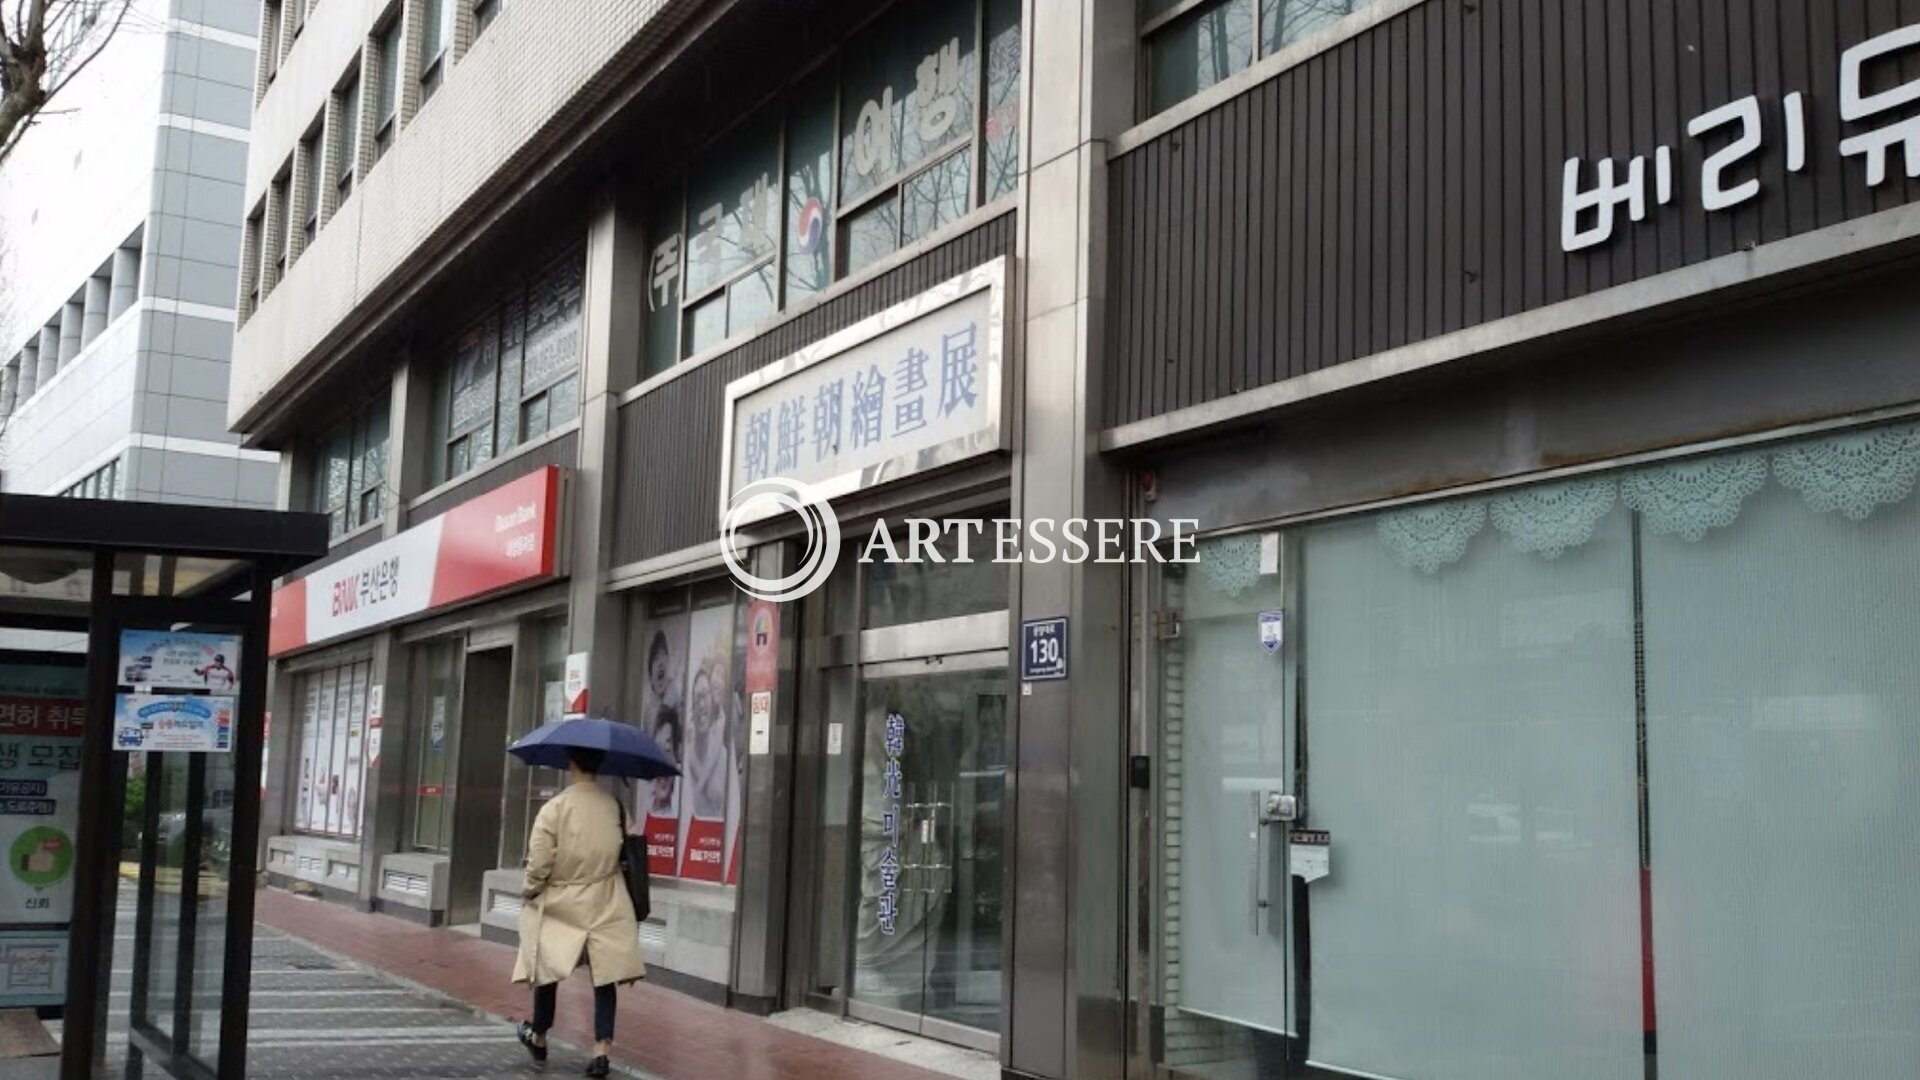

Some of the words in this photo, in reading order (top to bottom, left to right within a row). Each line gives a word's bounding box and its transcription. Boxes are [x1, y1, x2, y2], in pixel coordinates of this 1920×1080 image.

[854, 36, 961, 176] 여행
[331, 574, 360, 617] BNK
[359, 555, 400, 609] 부산은행
[1030, 637, 1059, 664] 130
[0, 703, 39, 729] 면허
[28, 745, 81, 771] 모집
[24, 895, 50, 912] 신뢰
